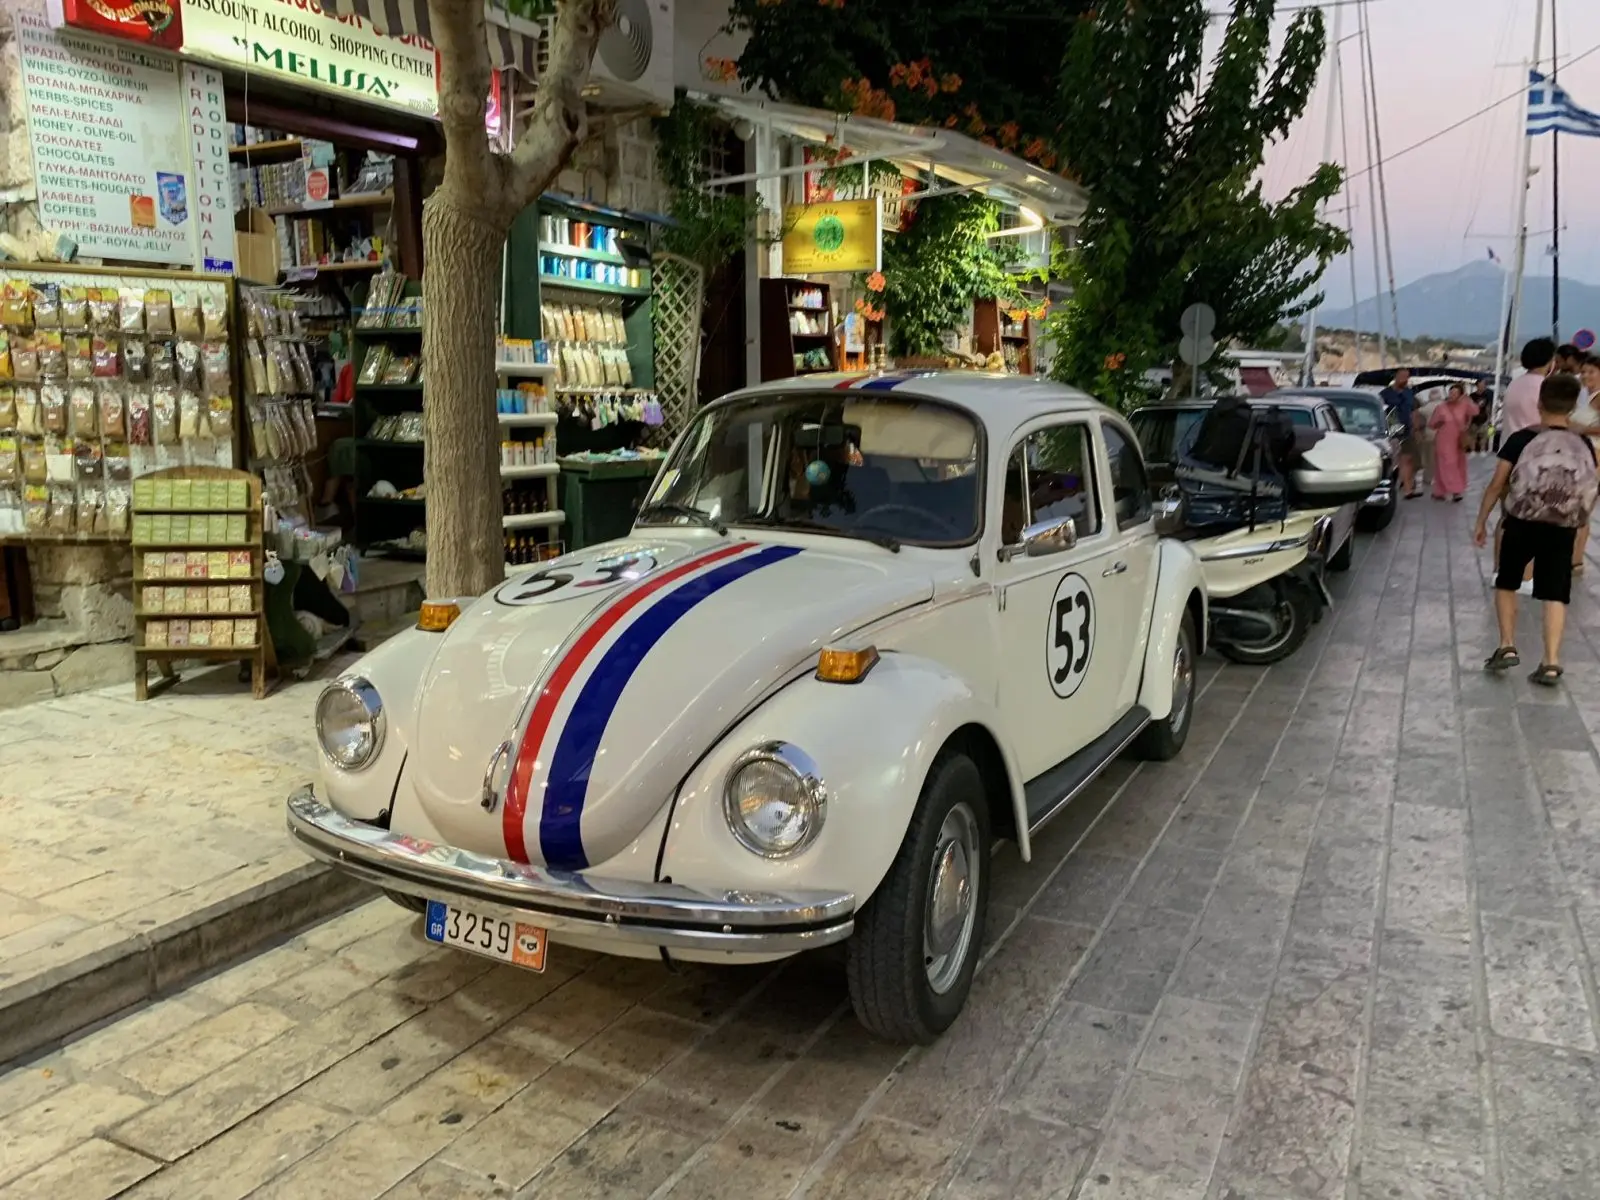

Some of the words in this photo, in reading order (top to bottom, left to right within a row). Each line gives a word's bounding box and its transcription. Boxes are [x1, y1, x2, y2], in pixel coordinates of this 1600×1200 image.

[263, 12, 324, 46] ALCOHOL
[330, 33, 388, 66] SHOPPING
[391, 52, 434, 79] CENTER
[29, 88, 114, 112] HERBS-SPICES
[33, 117, 74, 133] HONEY
[84, 126, 137, 144] OLIVE-OIL
[206, 73, 226, 210] PRODUCTS
[35, 133, 103, 152] ΣΟΚΟΛΑΤΕΣ
[37, 146, 115, 167] CHOCOLATES
[40, 174, 144, 197] SWEETS-NOUGATS
[42, 190, 95, 205] ΚΑΦΕΔΕΣ
[43, 203, 97, 218] COFFEES
[143, 241, 172, 252] JELLY
[513, 558, 639, 600] 53
[1054, 590, 1091, 684] 53
[430, 923, 443, 937] GR
[448, 908, 511, 954] 3259
